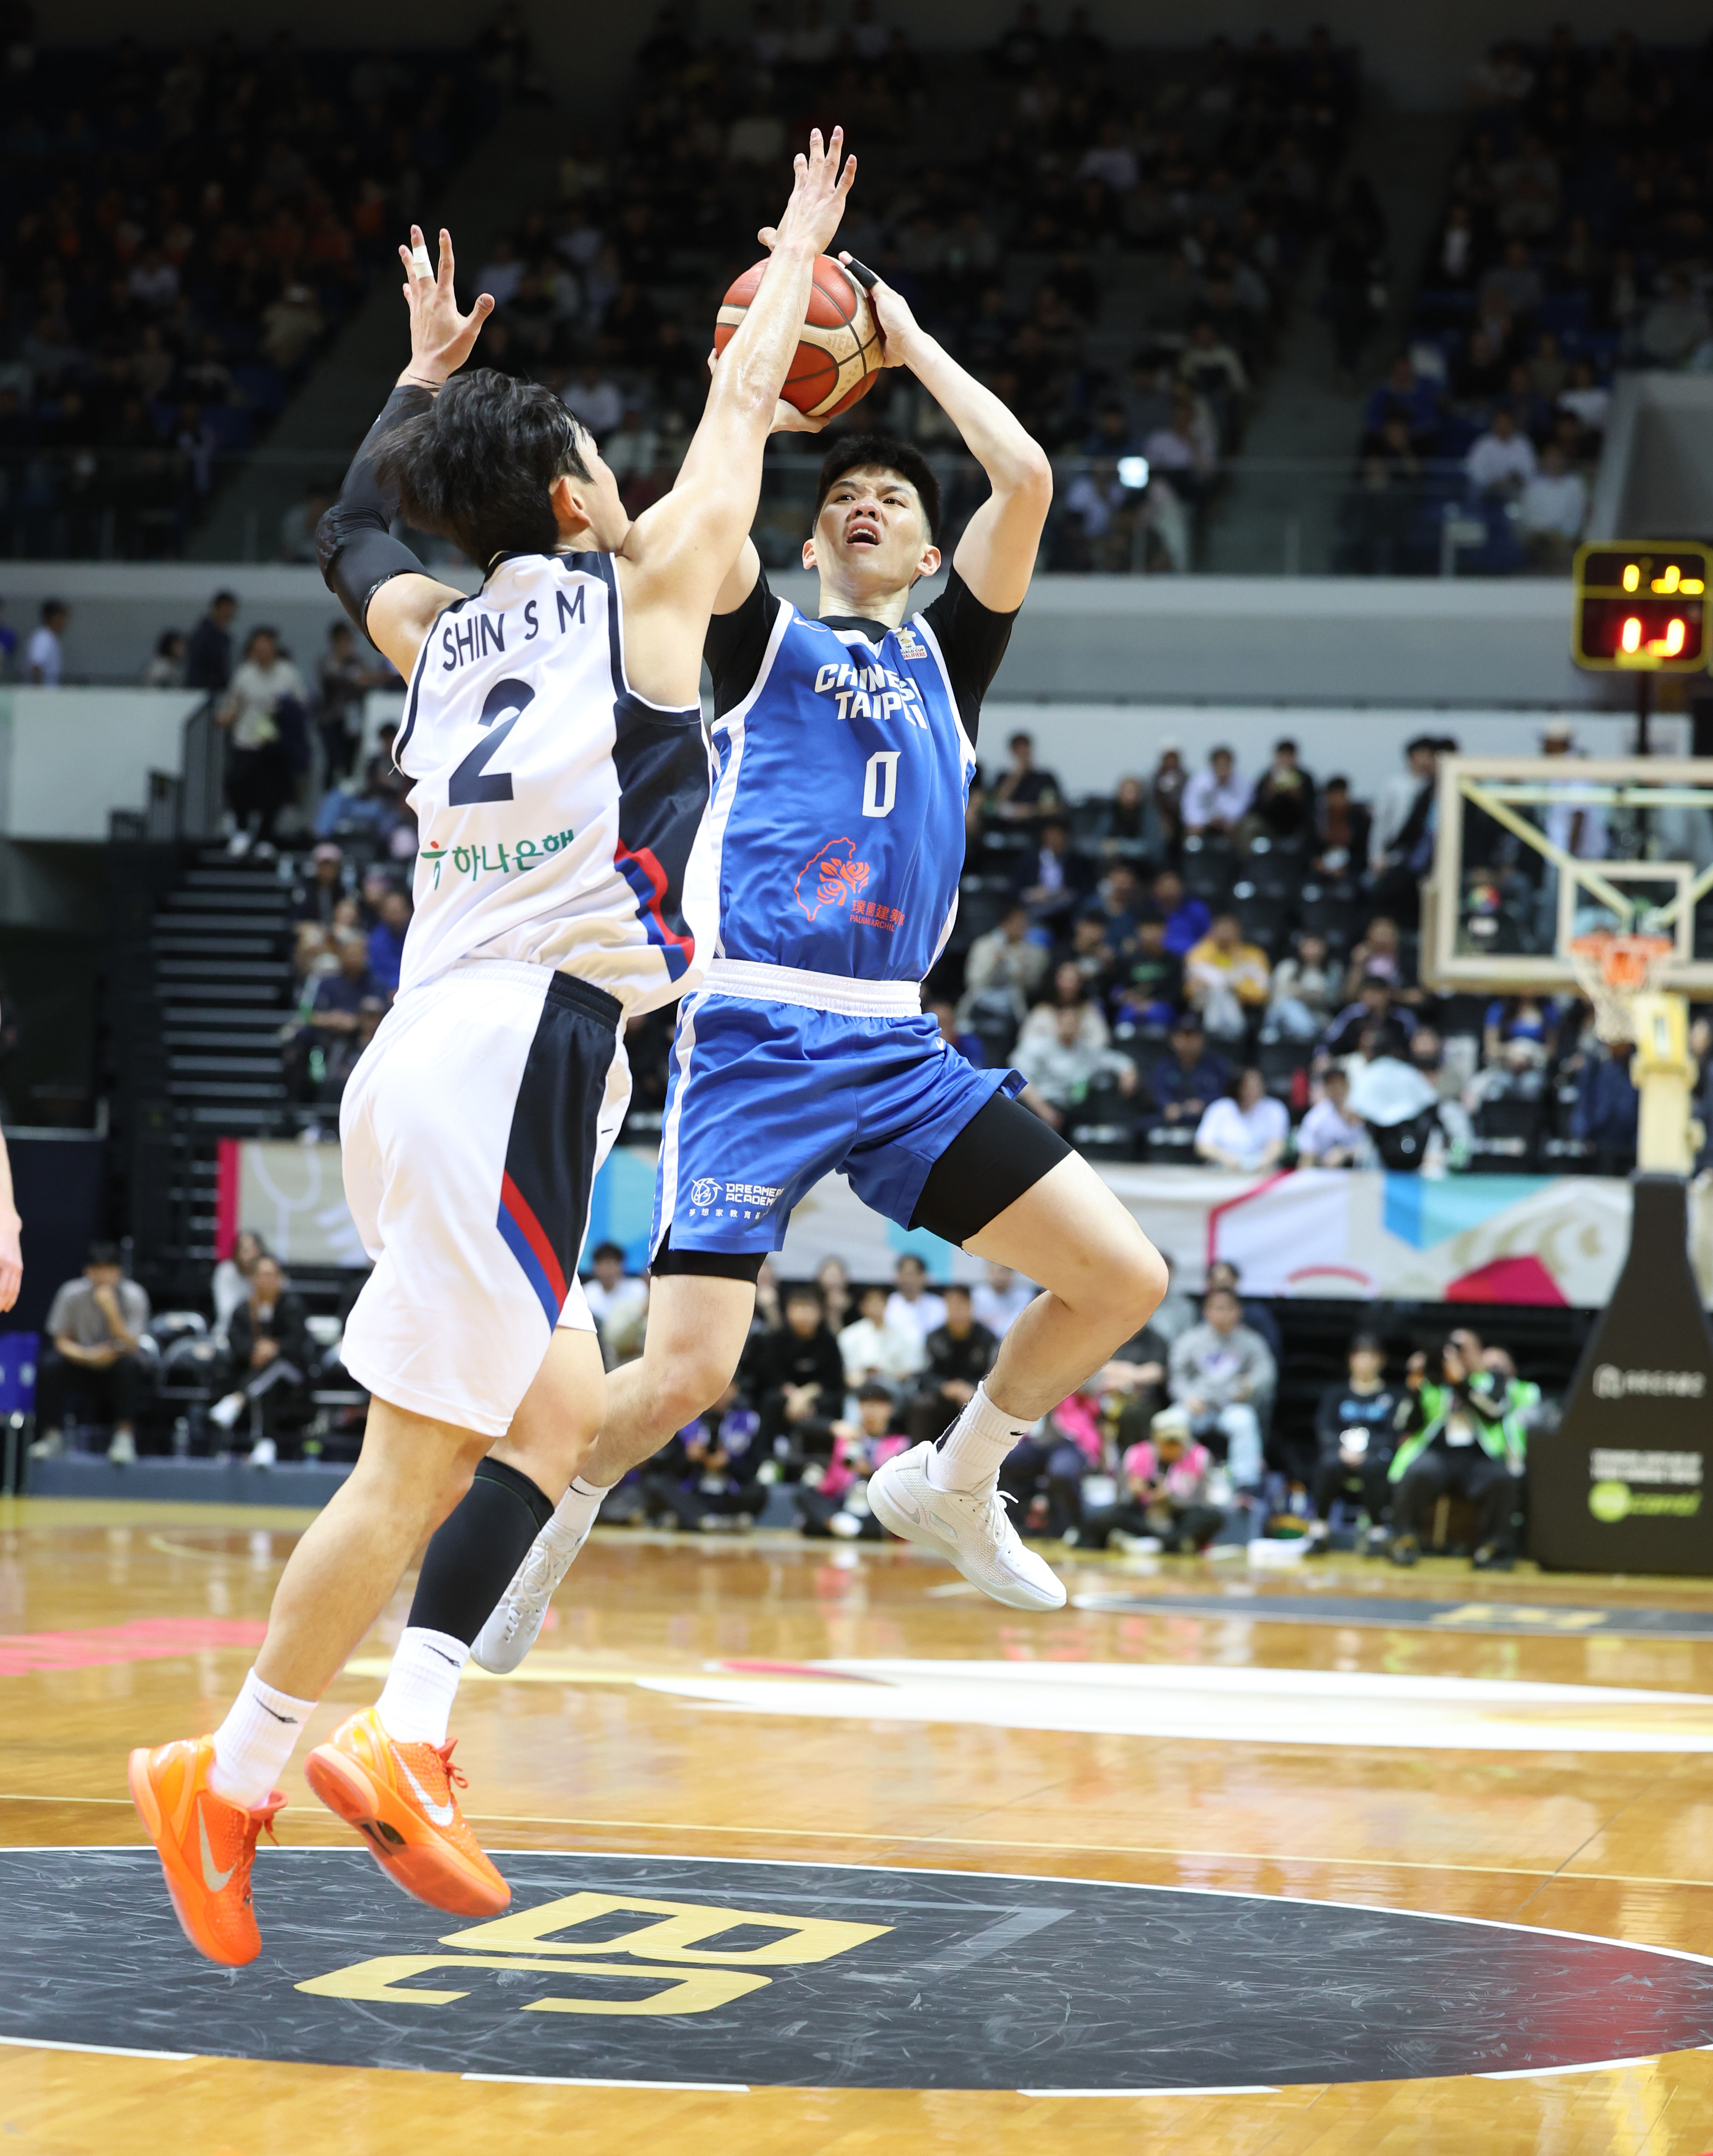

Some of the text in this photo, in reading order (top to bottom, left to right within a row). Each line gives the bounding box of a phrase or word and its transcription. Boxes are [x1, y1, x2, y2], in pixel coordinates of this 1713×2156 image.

[443, 585, 585, 671] SHIN S M
[448, 678, 536, 807] 2
[862, 751, 901, 818] 0
